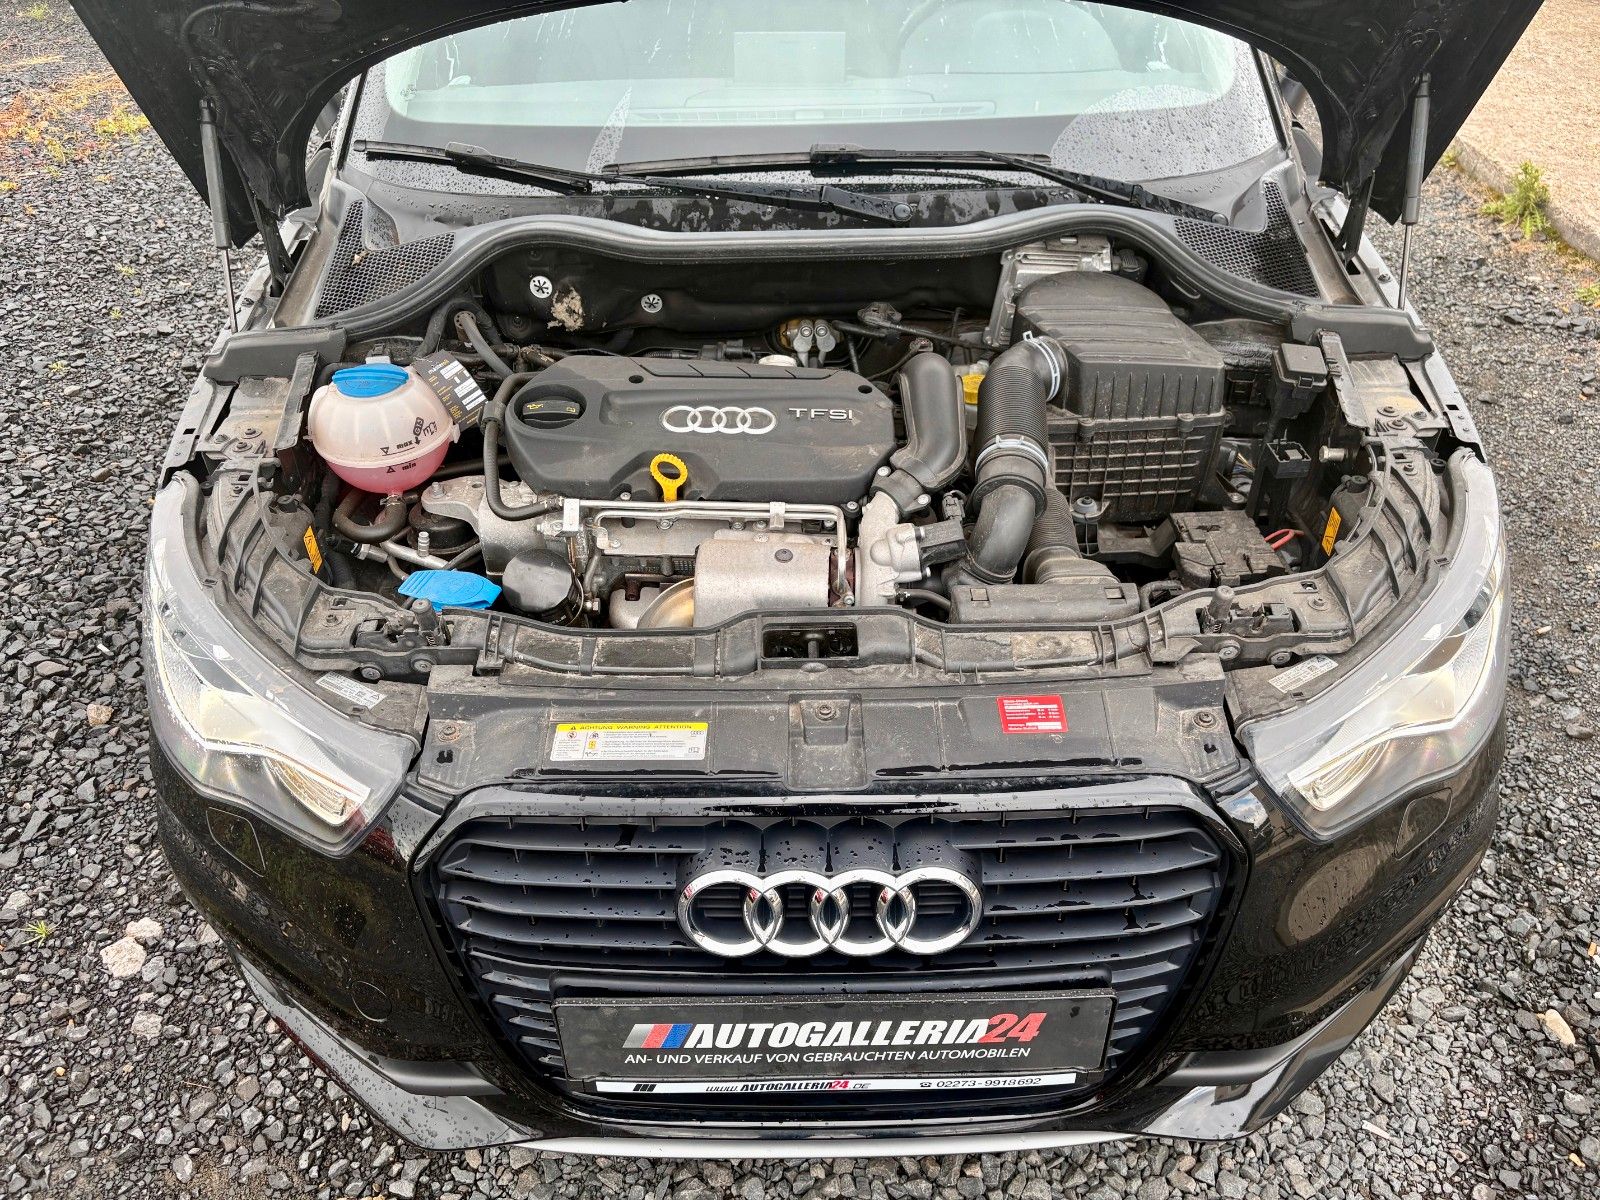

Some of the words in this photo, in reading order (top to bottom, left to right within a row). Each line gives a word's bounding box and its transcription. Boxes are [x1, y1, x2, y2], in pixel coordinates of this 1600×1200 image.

[788, 407, 853, 421] TFSI
[397, 440, 413, 449] max
[402, 463, 416, 471] min
[684, 1012, 1047, 1049] AUTOGALLERIA24
[624, 1054, 653, 1064] AN-
[656, 1054, 692, 1064] UND
[694, 1053, 763, 1064] VERKAUF
[765, 1052, 800, 1063] VON
[802, 1051, 916, 1063] GEBRAUCHTEN
[918, 1047, 1031, 1060] AUTOMOBILEN
